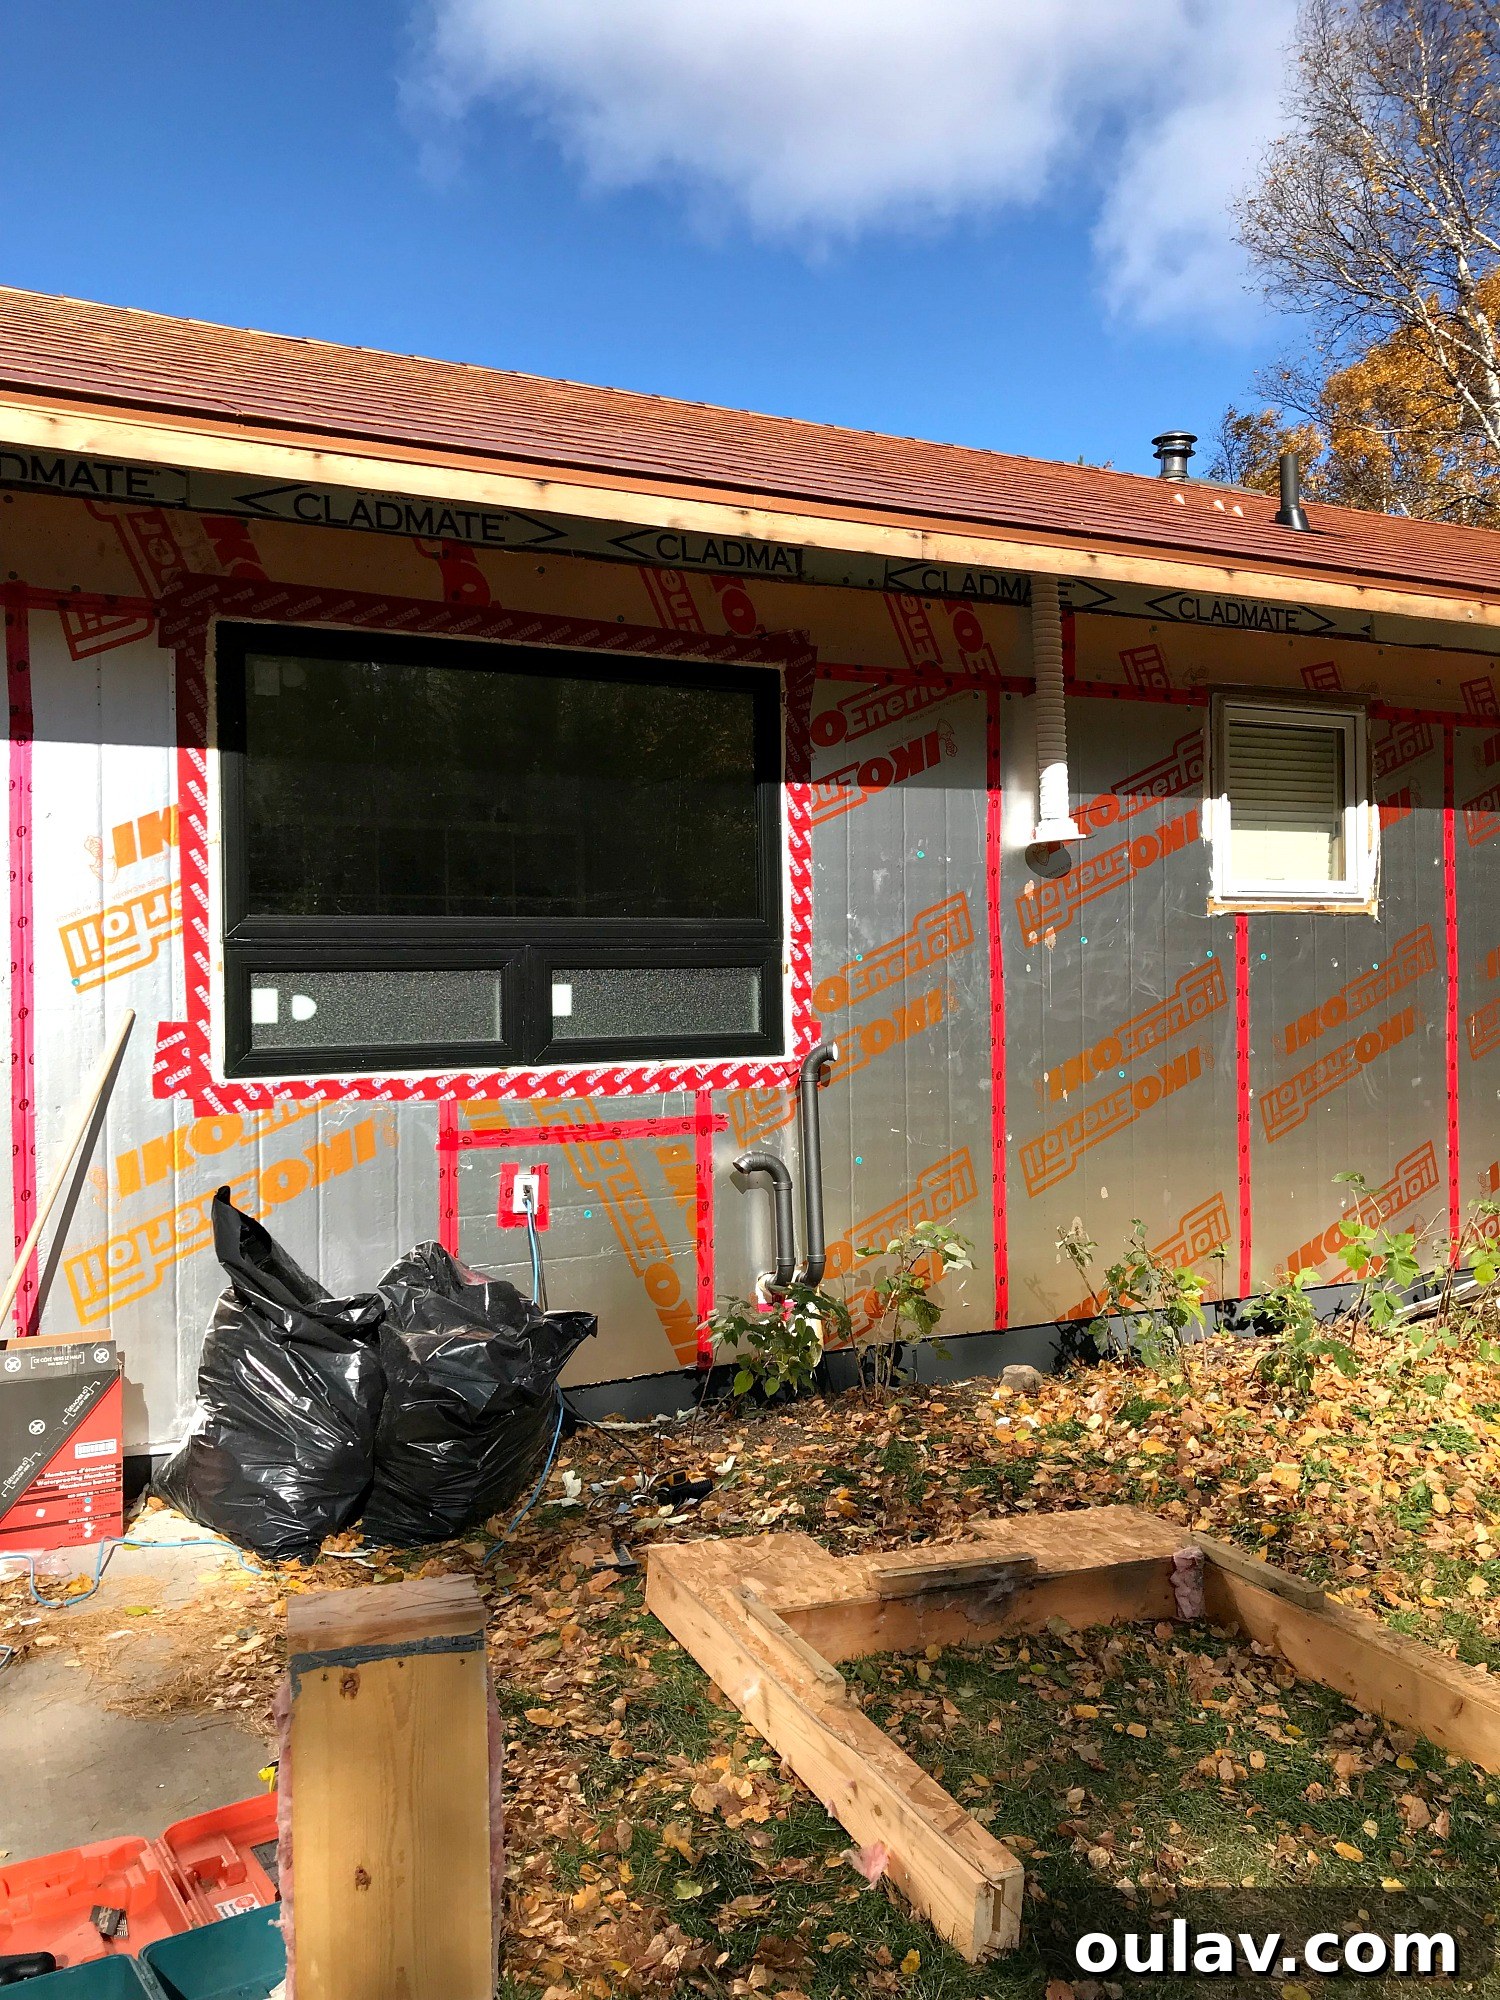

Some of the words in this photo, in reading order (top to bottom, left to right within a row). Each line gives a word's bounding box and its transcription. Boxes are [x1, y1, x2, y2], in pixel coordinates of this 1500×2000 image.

[0, 453, 155, 498] DMATE
[294, 493, 506, 542] CLADMATE
[656, 534, 804, 575] CLADMAT
[922, 569, 1072, 605] CLADMAE
[1178, 597, 1299, 631] CLADMATE
[857, 730, 941, 793] IKO
[1129, 809, 1199, 869] IKO
[847, 897, 971, 998] Enerfoil
[1350, 928, 1435, 1015] Enerfoil
[861, 988, 942, 1056] IKO
[1120, 961, 1227, 1059] Enerfoil
[1285, 996, 1347, 1057] IKO
[1354, 1006, 1415, 1064] IKO
[1050, 1036, 1122, 1102] IKO
[1132, 1046, 1202, 1111] IKO
[1262, 1043, 1356, 1140] Enerfoil
[116, 1114, 243, 1198] IKO
[259, 1118, 376, 1204] IKO
[1021, 1088, 1134, 1192] Enerfoil
